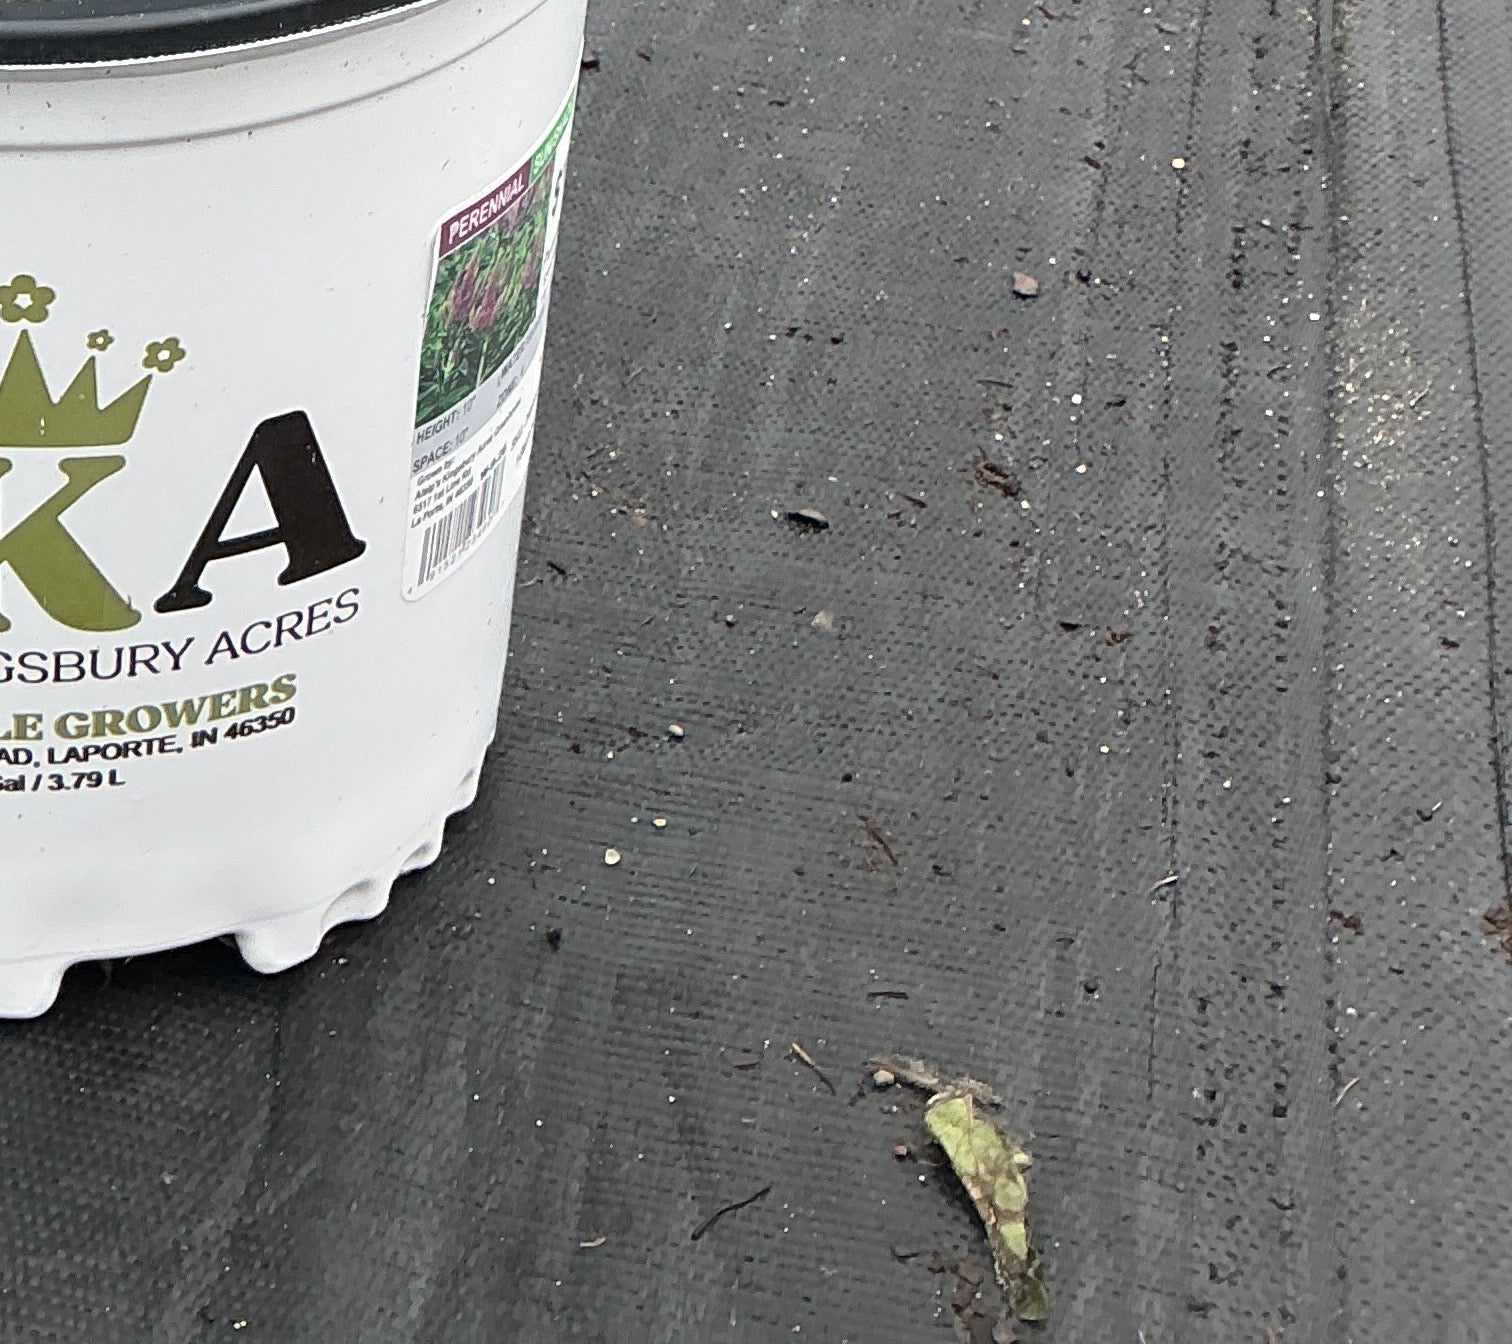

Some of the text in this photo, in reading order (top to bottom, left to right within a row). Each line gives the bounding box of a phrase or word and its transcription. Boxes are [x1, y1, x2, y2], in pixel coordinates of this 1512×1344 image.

[448, 172, 525, 244] PERENNIAL
[204, 588, 360, 665] ACRES
[53, 673, 297, 739] GROWERS
[191, 726, 218, 748] IN
[223, 706, 296, 739] 46350
[31, 773, 43, 792] /
[48, 770, 103, 791] 3.79
[109, 769, 126, 787] L
